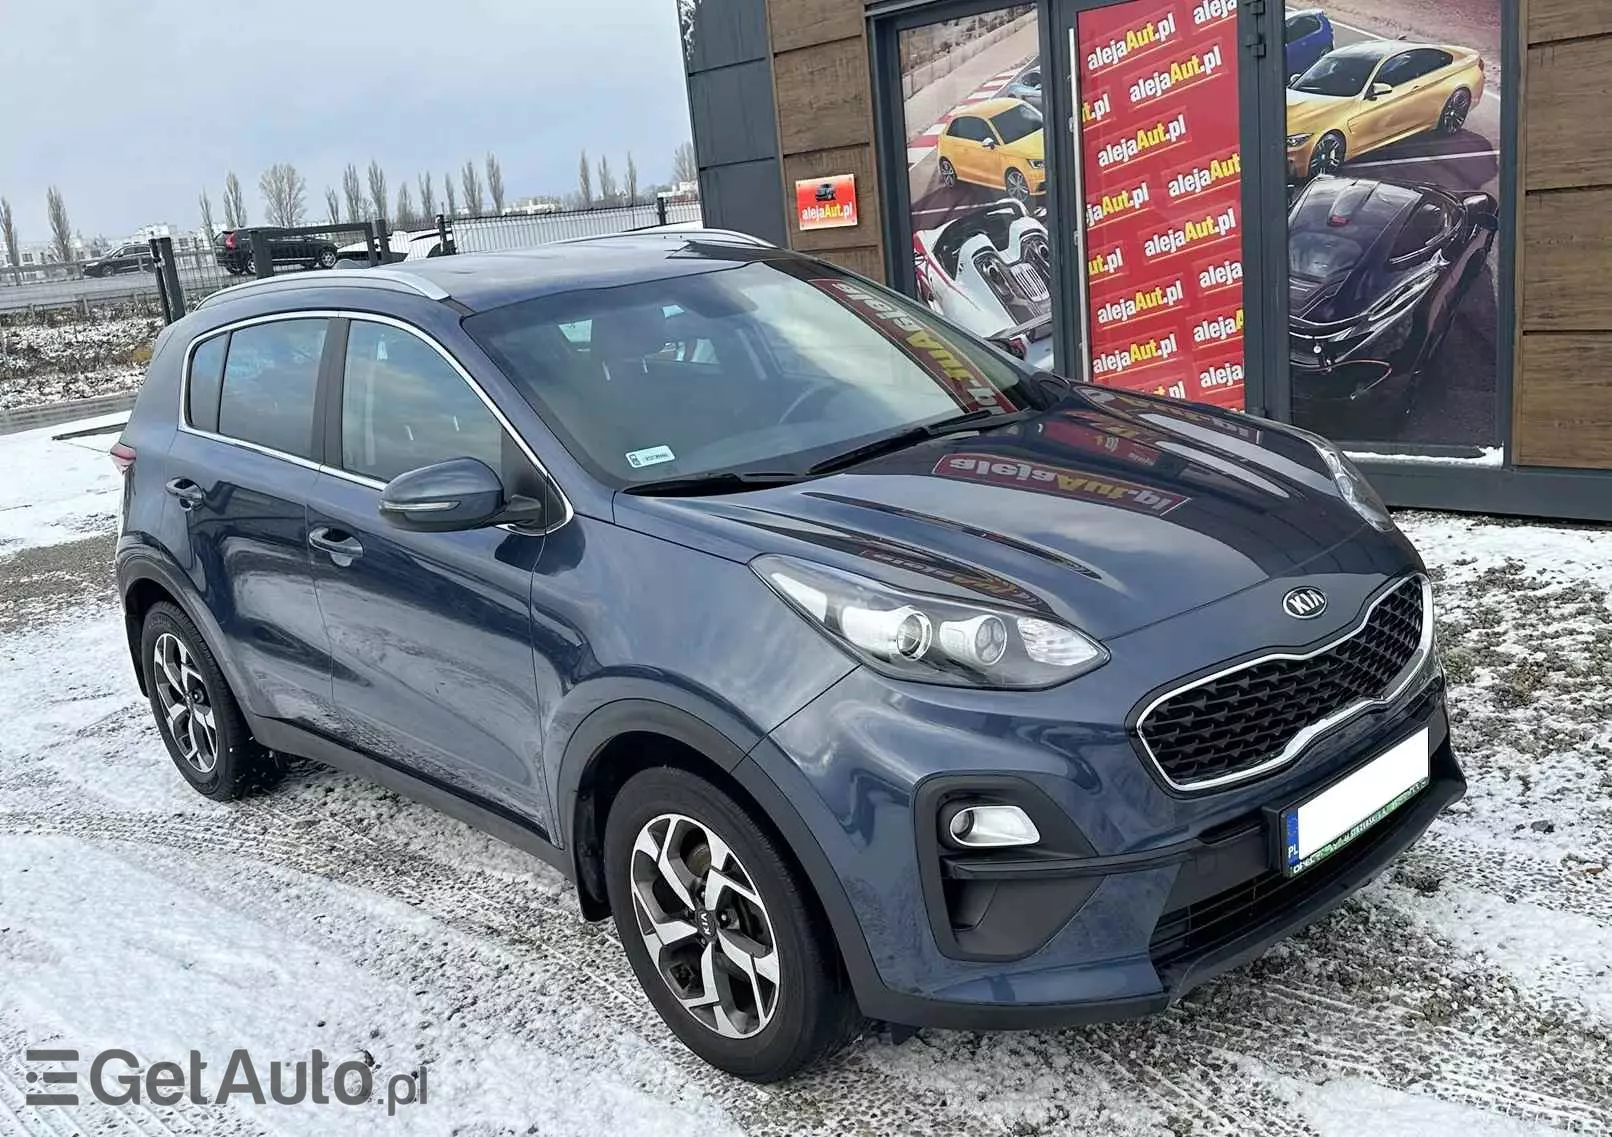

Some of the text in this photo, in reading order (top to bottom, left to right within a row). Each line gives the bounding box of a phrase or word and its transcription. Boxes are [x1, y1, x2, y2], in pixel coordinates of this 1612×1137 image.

[1087, 12, 1176, 70] alejaAut.pl
[1129, 45, 1222, 102] alejaAut.pl
[1098, 114, 1187, 167] alejaAut.pl
[802, 201, 853, 221] alejaAut.pl
[1086, 182, 1149, 227] jaAut.pl
[1144, 208, 1236, 256] alejaAut.pl
[1097, 280, 1183, 324] alejaAut.pl
[1092, 334, 1178, 373] alejaAut.pl
[1288, 589, 1325, 615] KIA
